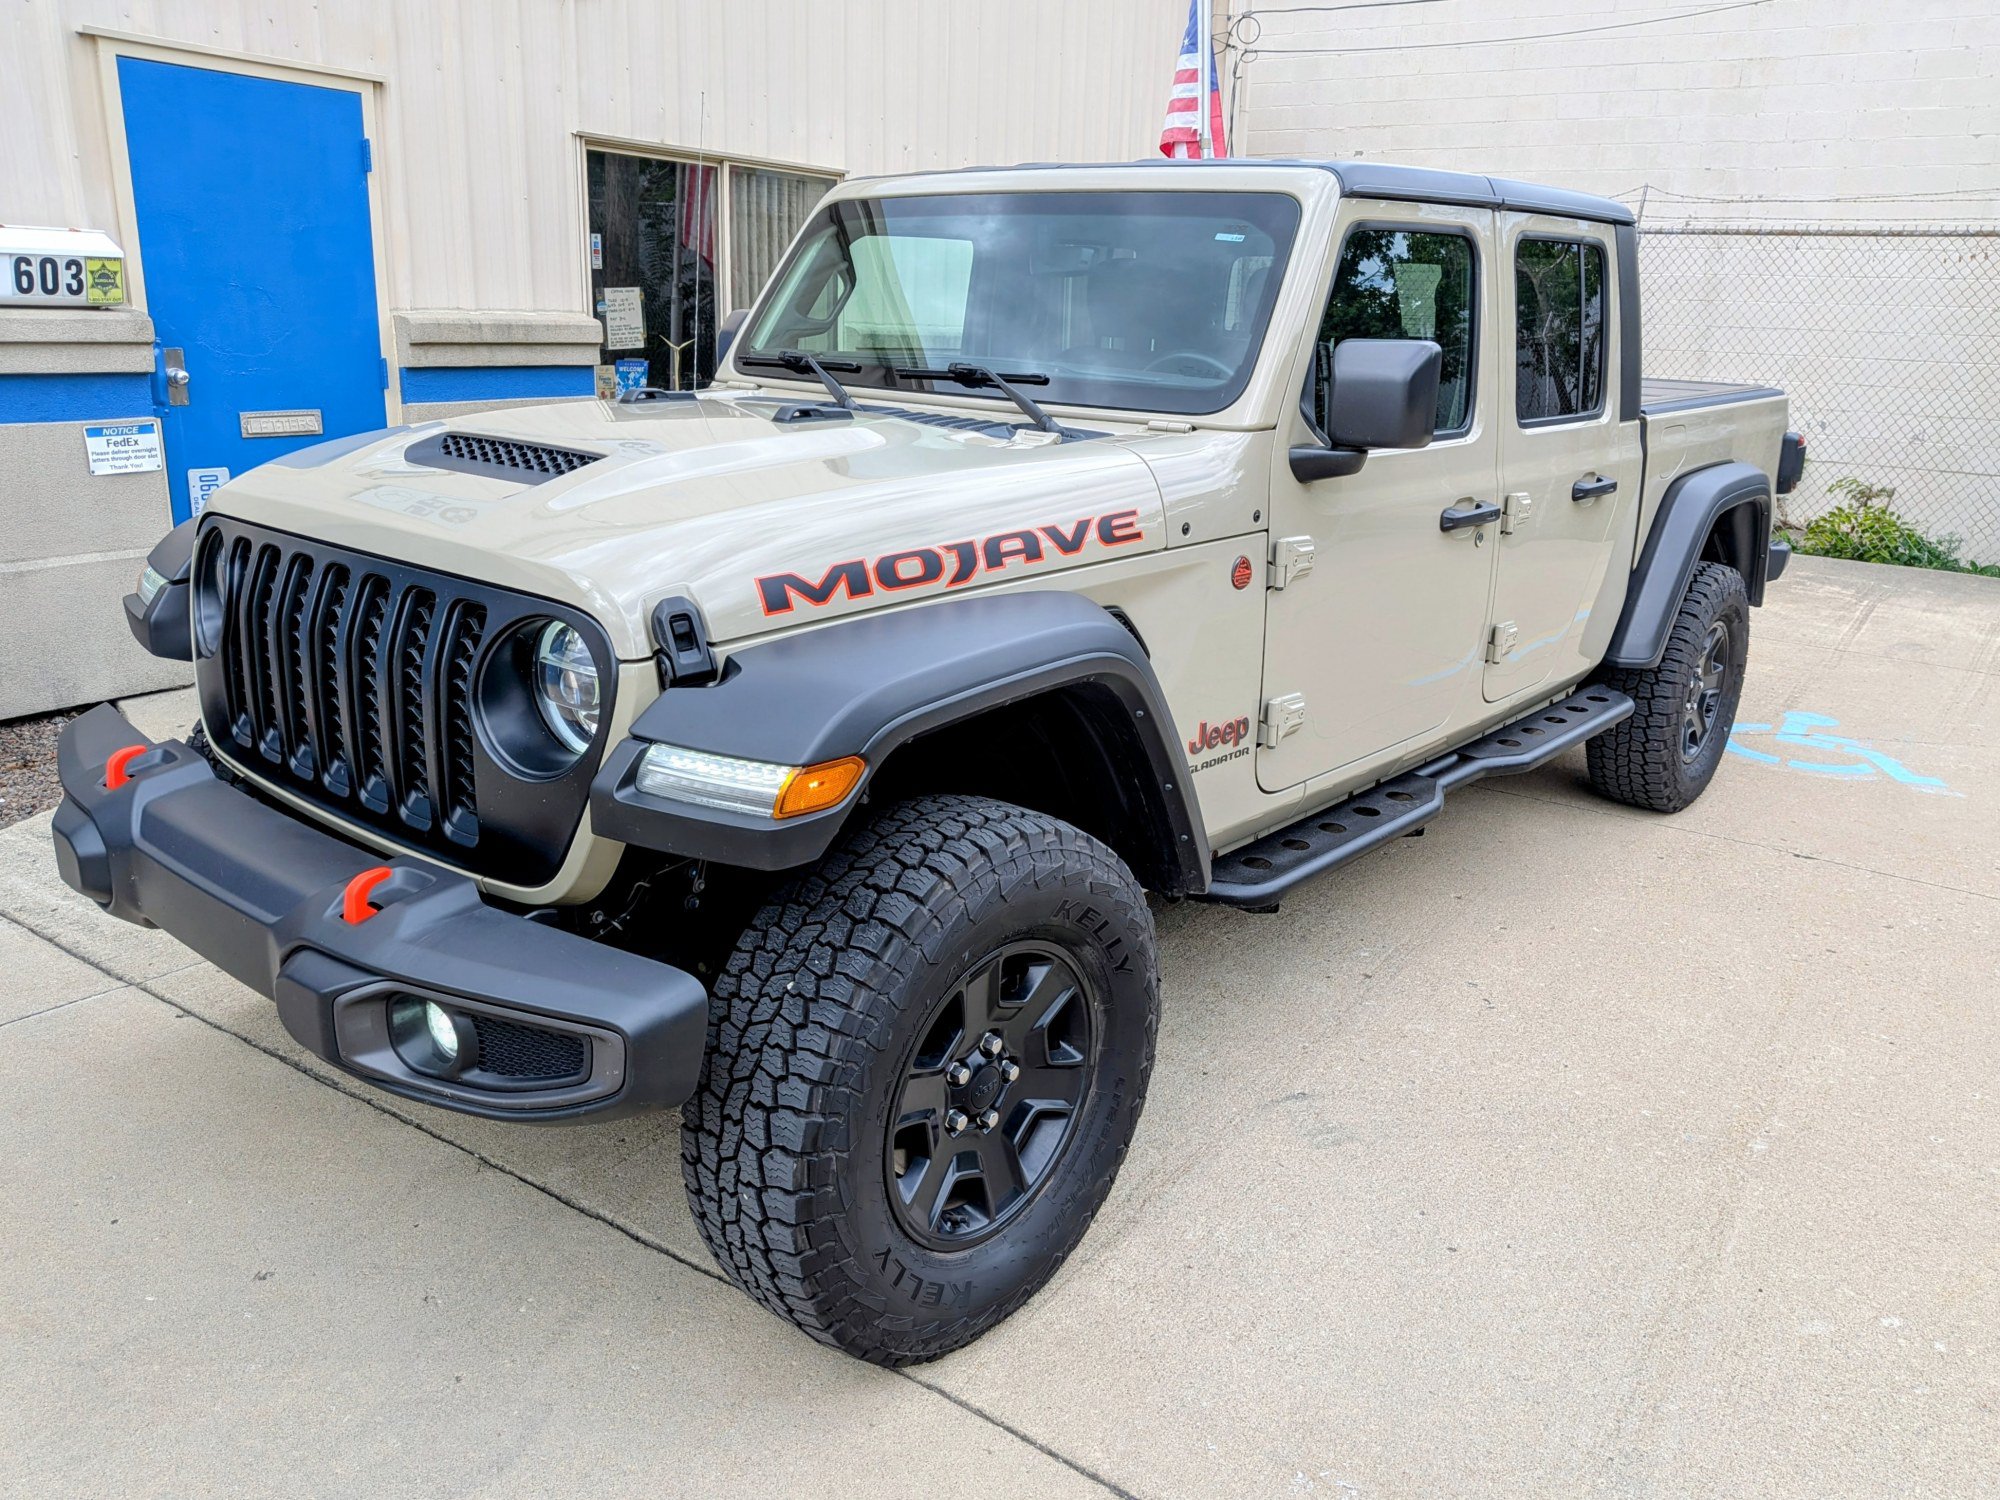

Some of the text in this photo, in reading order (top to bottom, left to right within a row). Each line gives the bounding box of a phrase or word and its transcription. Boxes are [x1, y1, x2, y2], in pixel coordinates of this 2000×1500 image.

[14, 256, 84, 296] 603
[102, 426, 139, 436] NOTICE
[106, 437, 139, 448] FedEx
[754, 508, 1144, 617] MOJAVE
[1188, 715, 1250, 756] Jeep
[1188, 747, 1250, 774] GLADIATOR
[1049, 898, 1135, 975] KELLY
[871, 1246, 973, 1311] KELLY
